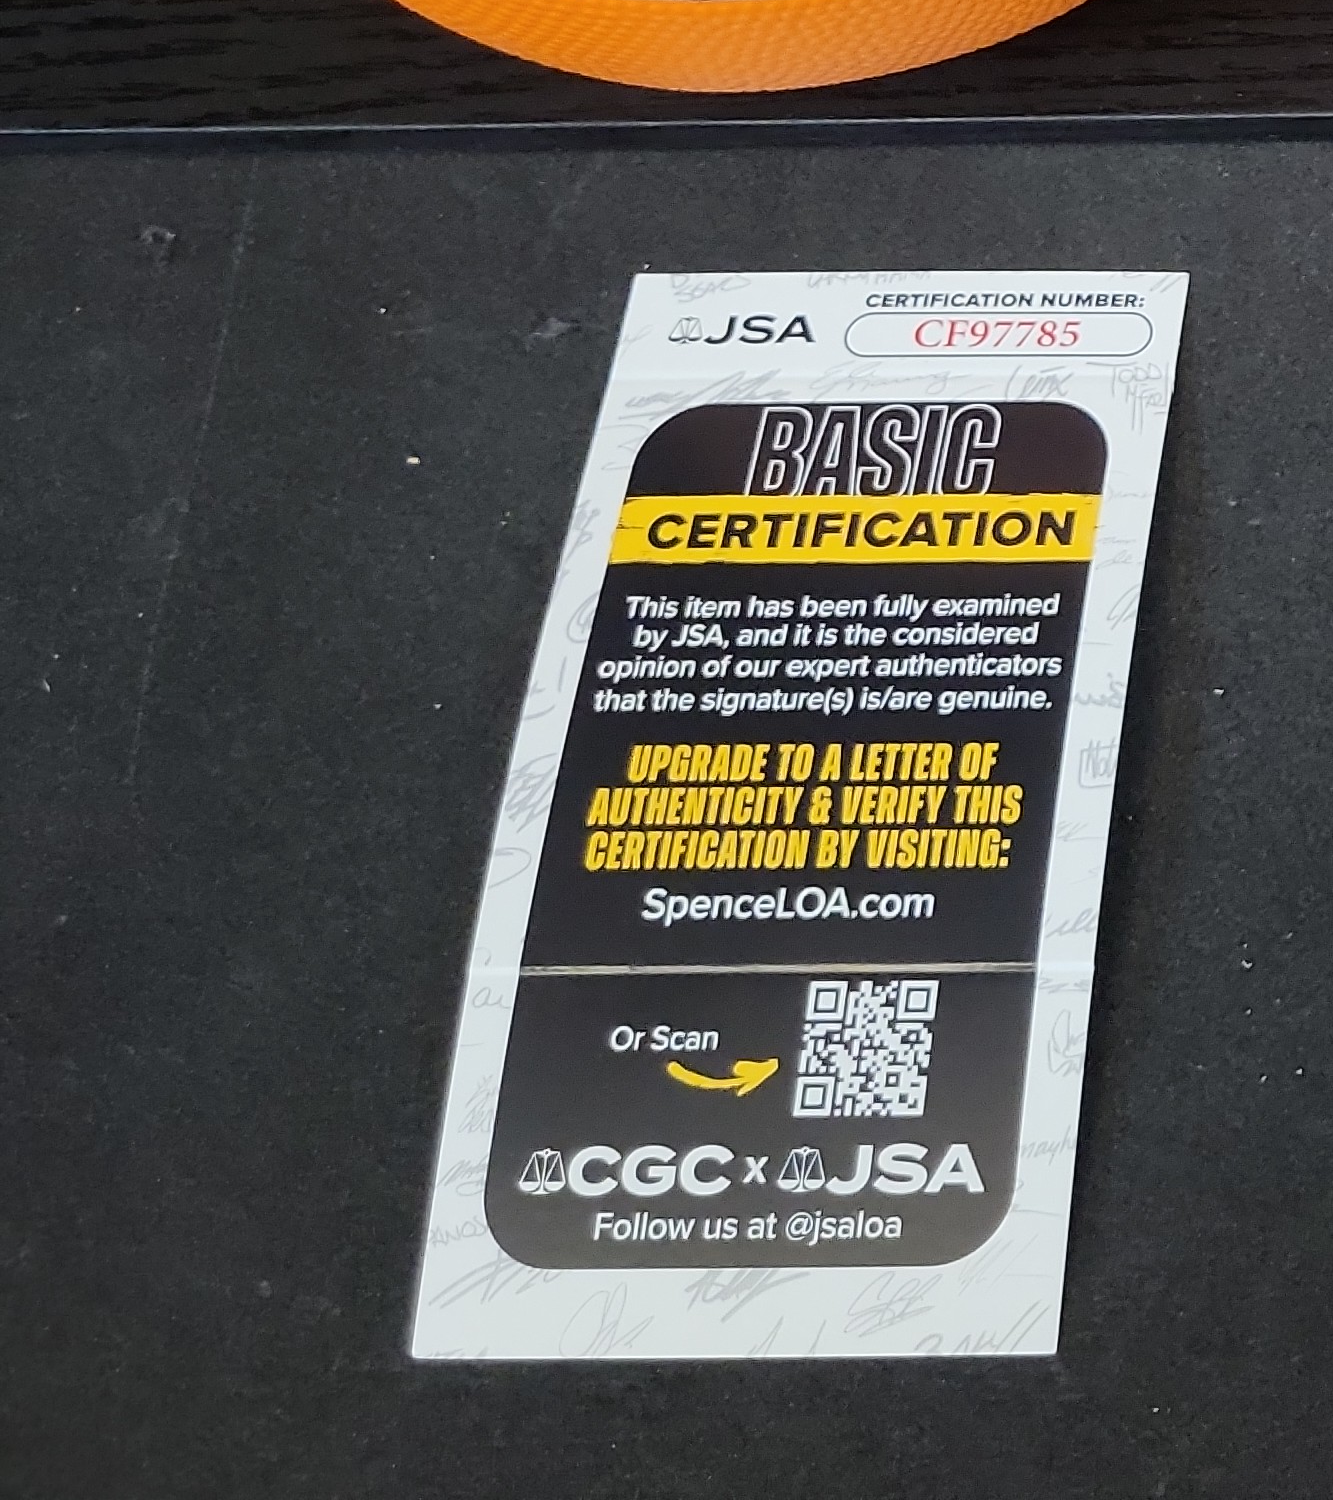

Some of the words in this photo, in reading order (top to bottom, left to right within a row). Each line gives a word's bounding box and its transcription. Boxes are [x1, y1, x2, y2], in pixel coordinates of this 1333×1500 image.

[865, 294, 1034, 309] CERTIFICATION
[1040, 294, 1146, 309] NUMBER:
[703, 315, 816, 345] JSA
[914, 321, 1082, 348] CF97785
[744, 404, 1003, 497] BASIC
[647, 511, 1076, 549] CERTIFICATION
[625, 595, 680, 620] This
[683, 595, 742, 619] item
[747, 595, 795, 619] has
[799, 594, 868, 619] been
[872, 593, 930, 623] fully
[931, 592, 1061, 617] examined
[632, 624, 669, 653] by
[670, 623, 730, 650] JSA,
[735, 623, 789, 647] and
[843, 622, 888, 647] the
[891, 621, 1041, 647] considered
[596, 654, 697, 684] opinion
[700, 654, 734, 679] of
[733, 659, 783, 678] our
[784, 655, 872, 683] expert
[874, 651, 1063, 677] authenticators
[592, 688, 648, 713] that
[651, 687, 696, 713] the
[699, 686, 855, 717] signature(s)
[859, 685, 933, 711] is/are
[937, 684, 1053, 716] genuine.
[627, 743, 771, 784] UPGRADE
[775, 743, 815, 783] TO
[848, 742, 953, 783] LETTER
[958, 742, 1000, 782] OF
[584, 785, 805, 827] AUTHENTICITY
[840, 785, 948, 826] VERIFY
[952, 784, 1024, 825] THIS
[583, 829, 811, 872] CERTIFICATION
[814, 829, 861, 869] BY
[866, 828, 1012, 869] VISITING:
[640, 886, 935, 928] SpenceLOA.com
[607, 1025, 647, 1053] Or
[649, 1025, 719, 1052] Scan
[567, 1145, 733, 1197] CGC
[825, 1143, 985, 1195] JSA
[589, 1211, 696, 1242] Follow
[700, 1217, 739, 1242] us
[743, 1211, 778, 1242] at
[781, 1209, 903, 1249] @jsaloa
